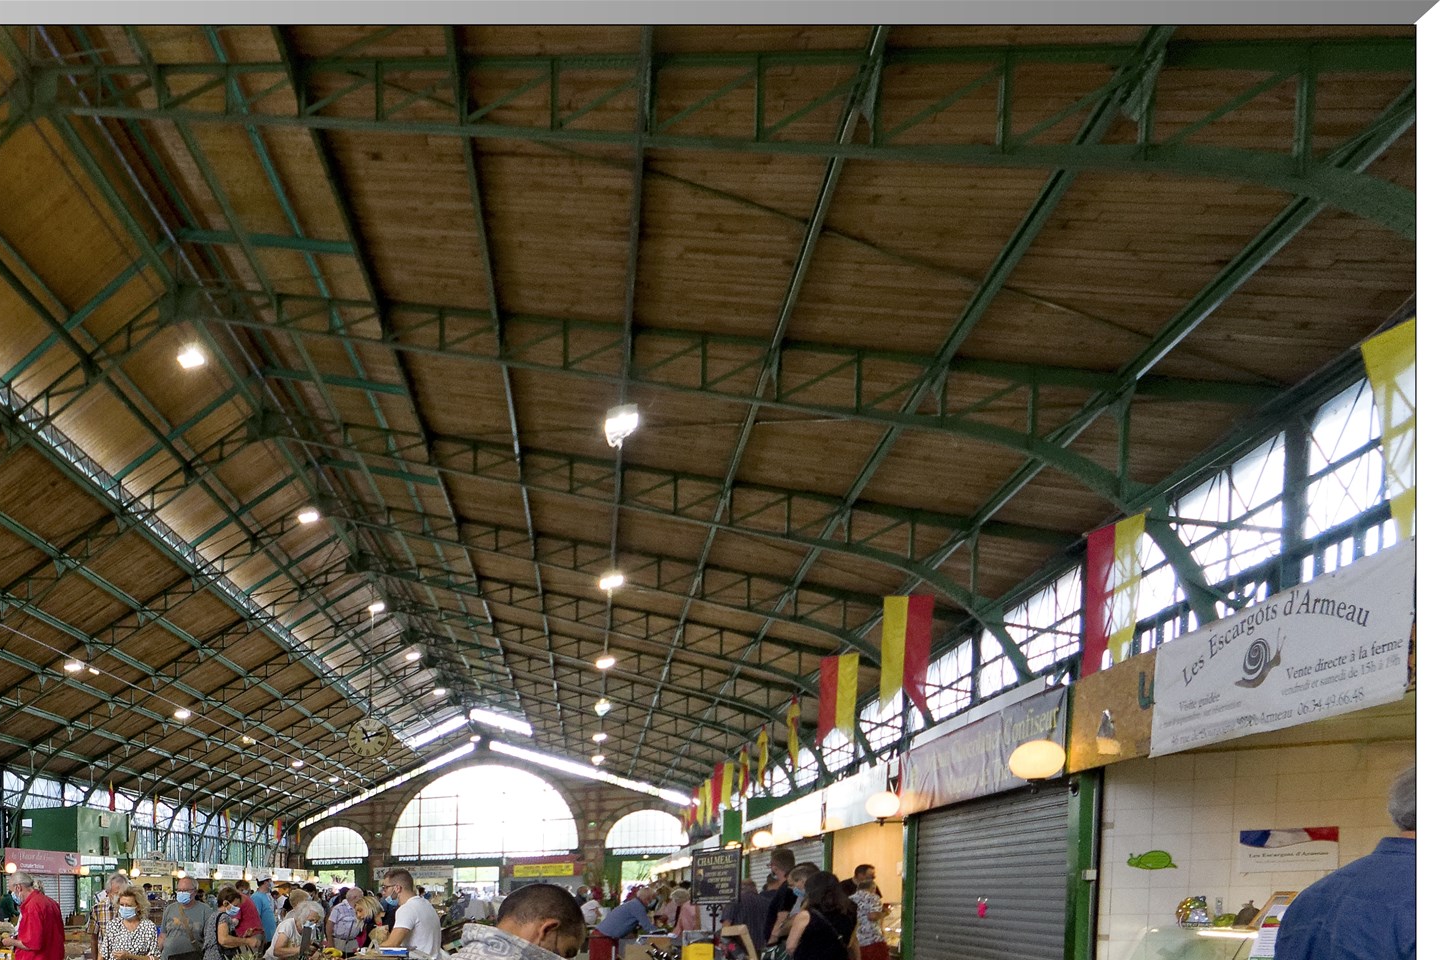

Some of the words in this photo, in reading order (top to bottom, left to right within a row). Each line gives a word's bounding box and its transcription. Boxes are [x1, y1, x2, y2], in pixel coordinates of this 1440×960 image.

[1182, 655, 1205, 687] Les
[1208, 604, 1278, 659] Escargots
[1283, 589, 1370, 627] d'Armeau
[1286, 665, 1312, 680] Vente
[1314, 655, 1347, 673] directe
[1349, 649, 1356, 662] à
[1358, 646, 1368, 659] la
[1371, 638, 1404, 656] ferme
[1004, 705, 1059, 745] Confiseur
